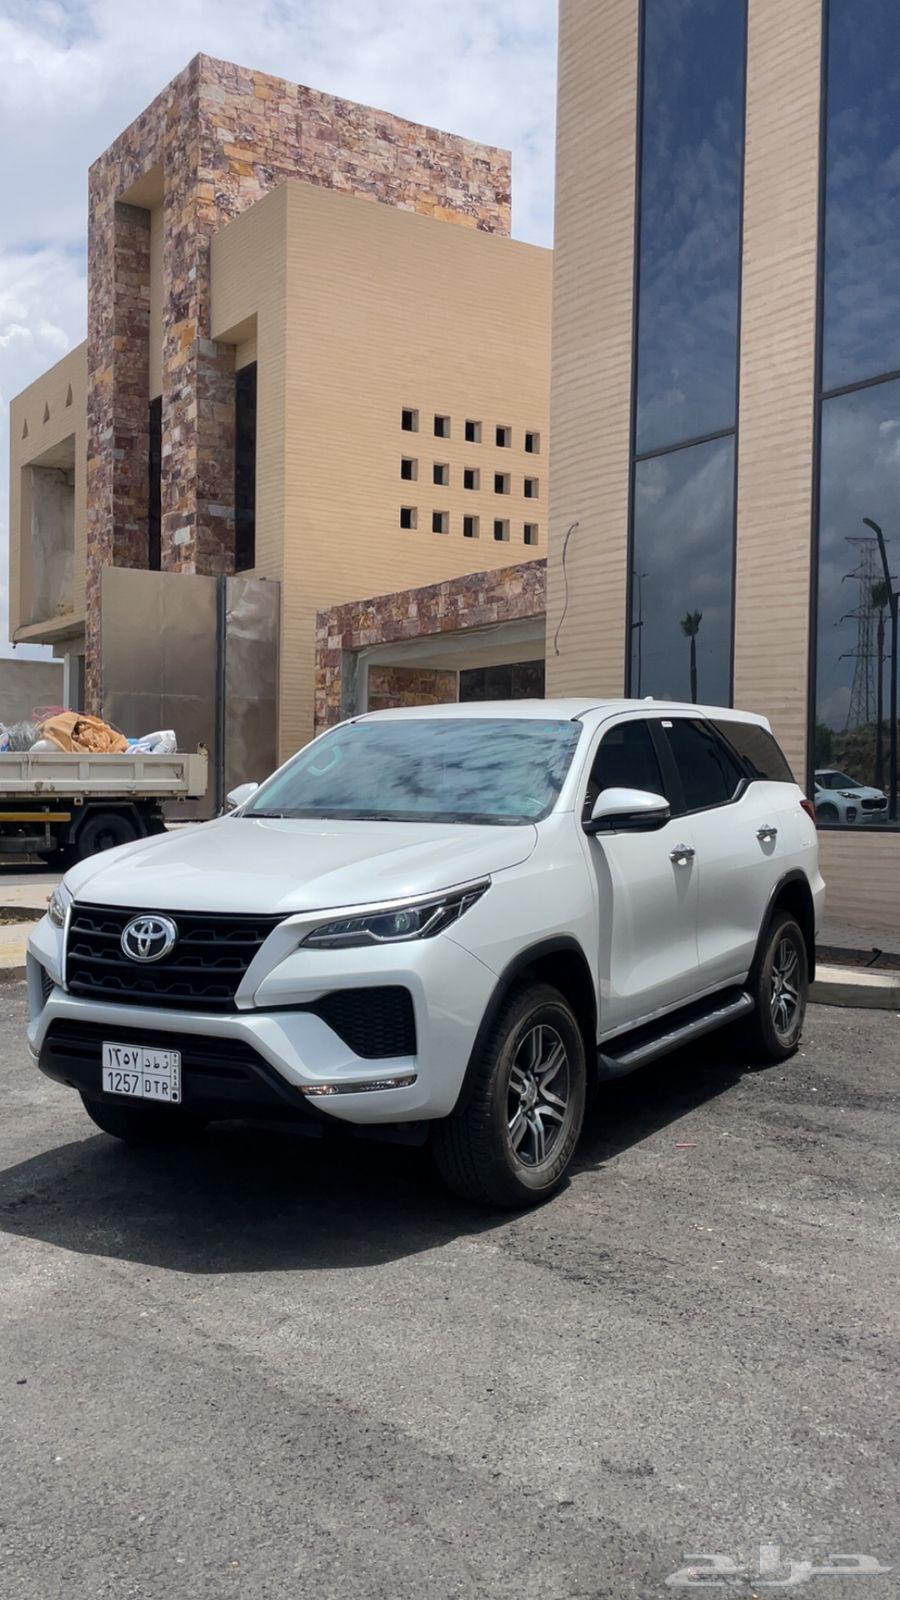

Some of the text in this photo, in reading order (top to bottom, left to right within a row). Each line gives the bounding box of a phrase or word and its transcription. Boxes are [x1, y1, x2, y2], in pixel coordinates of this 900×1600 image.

[108, 1047, 138, 1069] ١٢٥٧
[107, 1071, 169, 1096] 1257 DTR
